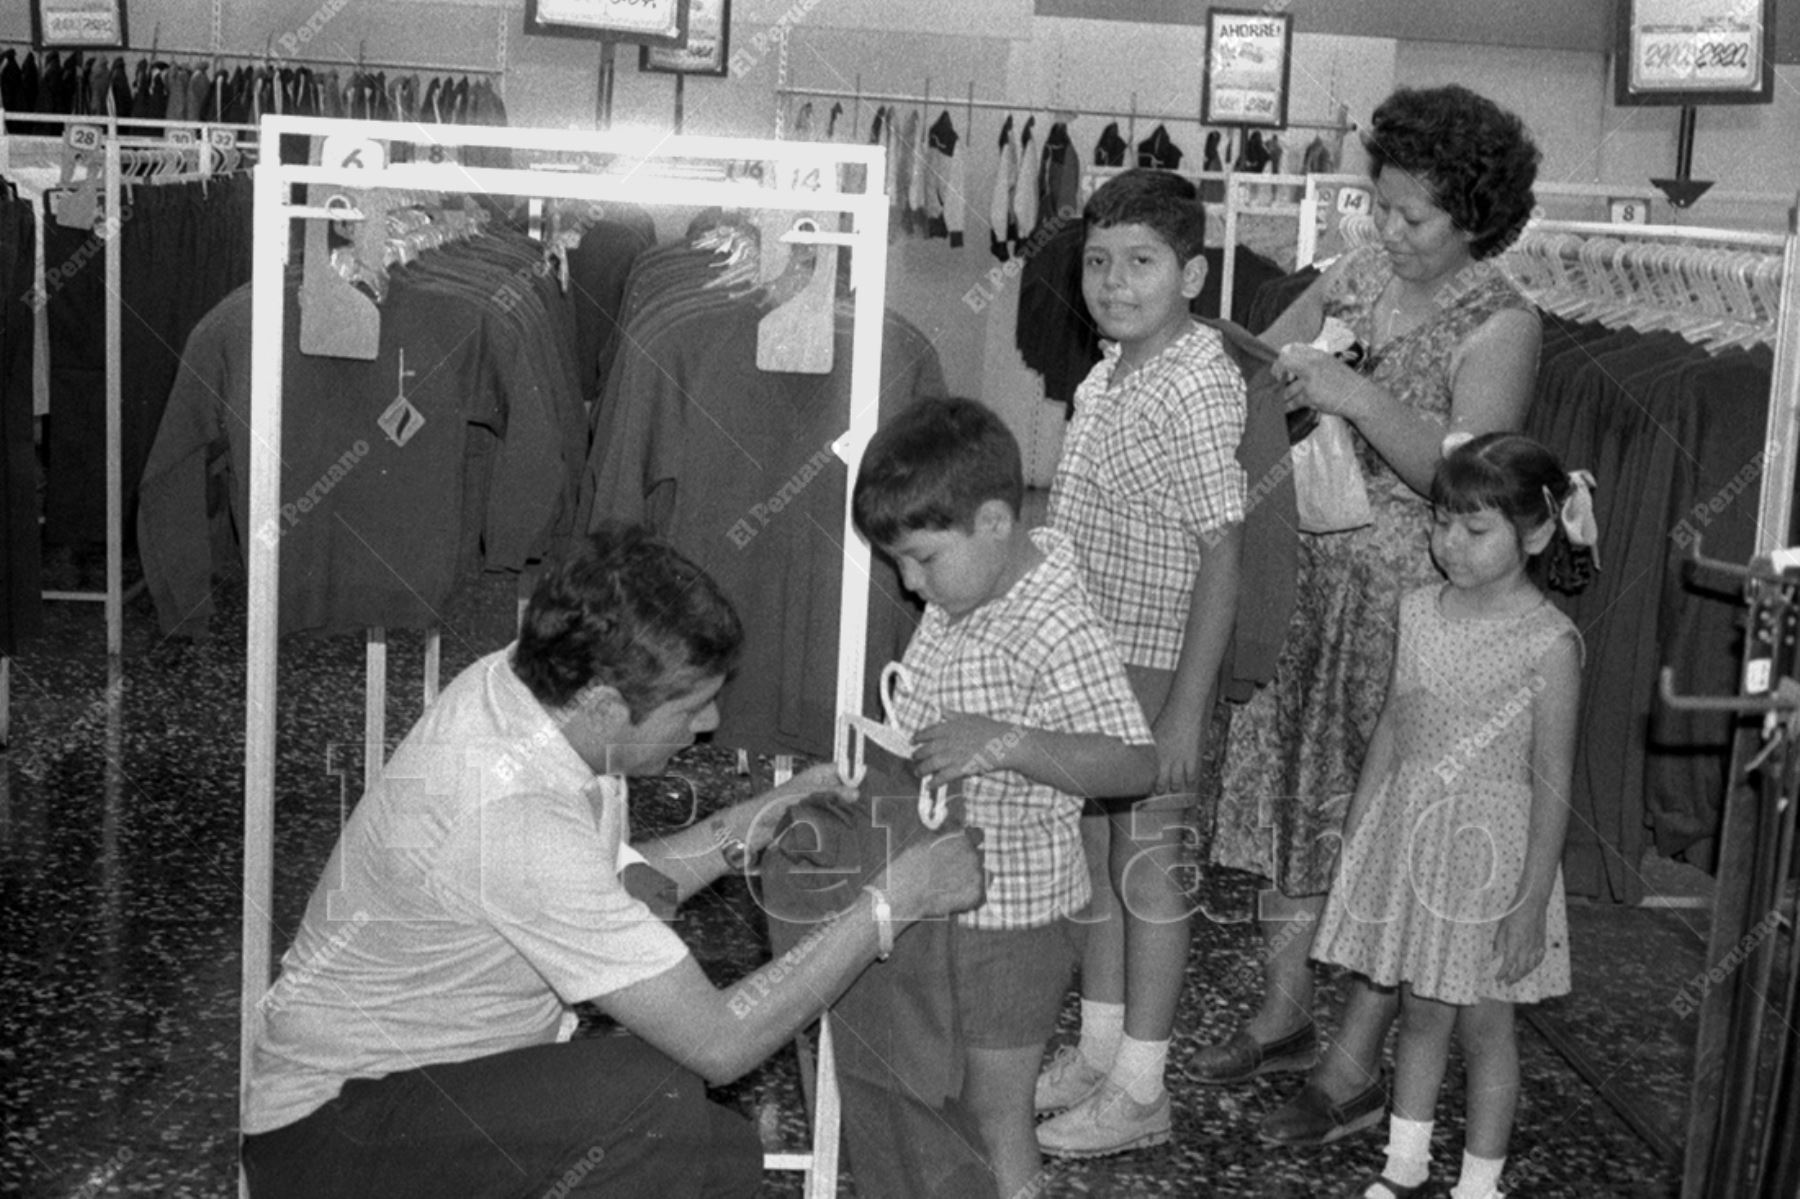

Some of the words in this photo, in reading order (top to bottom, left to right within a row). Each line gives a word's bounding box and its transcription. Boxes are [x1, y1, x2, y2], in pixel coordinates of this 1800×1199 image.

[1220, 23, 1282, 38] AHORRE!
[75, 130, 95, 146] 28
[429, 144, 444, 161] 8
[792, 167, 821, 192] 14
[1344, 194, 1362, 209] 14
[1622, 204, 1635, 222] 8
